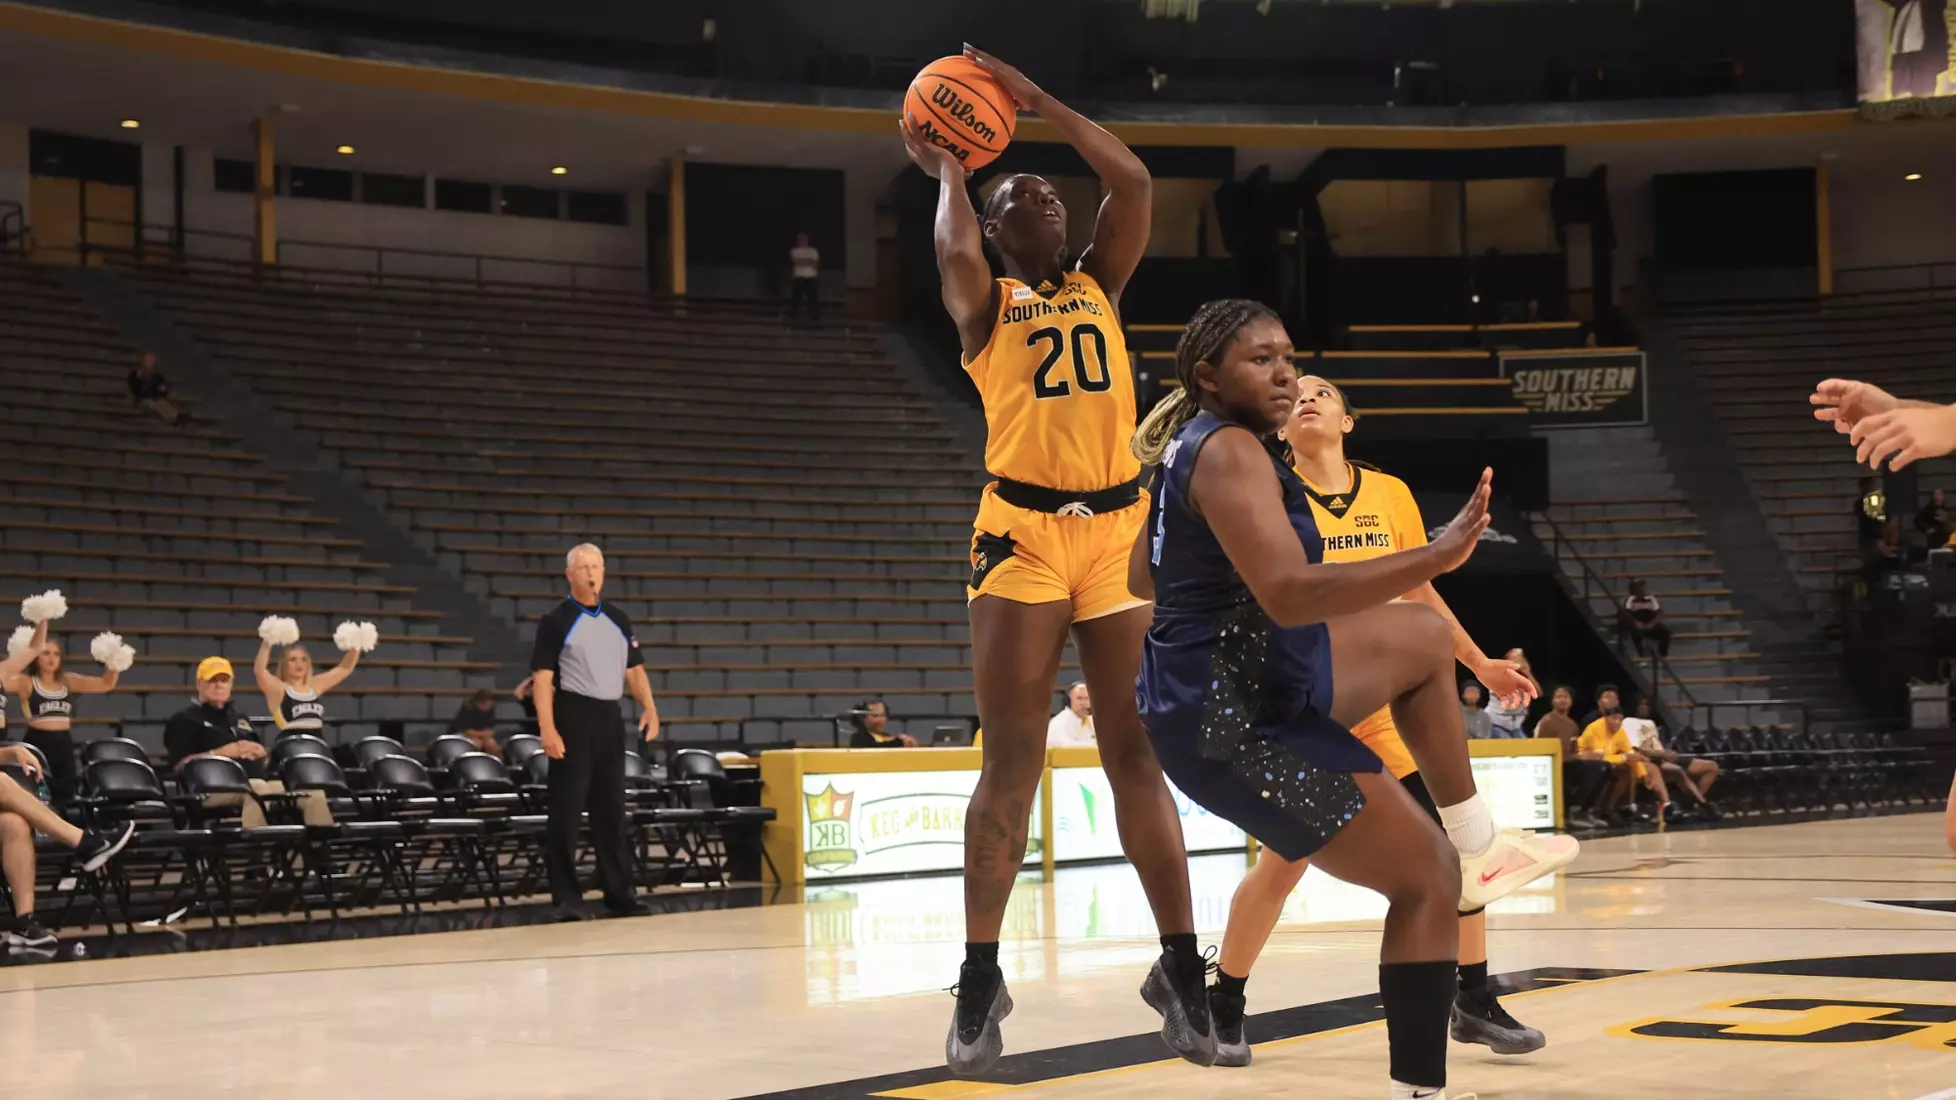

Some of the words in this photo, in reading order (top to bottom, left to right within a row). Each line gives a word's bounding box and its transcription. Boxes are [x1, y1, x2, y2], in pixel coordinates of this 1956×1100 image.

[932, 83, 996, 143] Wilson
[1026, 322, 1112, 400] 20
[1512, 366, 1637, 394] SOUTHERN
[1544, 392, 1595, 412] MISS
[1354, 514, 1380, 528] SBC
[1321, 534, 1363, 552] THERN
[1365, 532, 1390, 548] MISS
[869, 807, 900, 839] KEG
[921, 805, 965, 831] BARR
